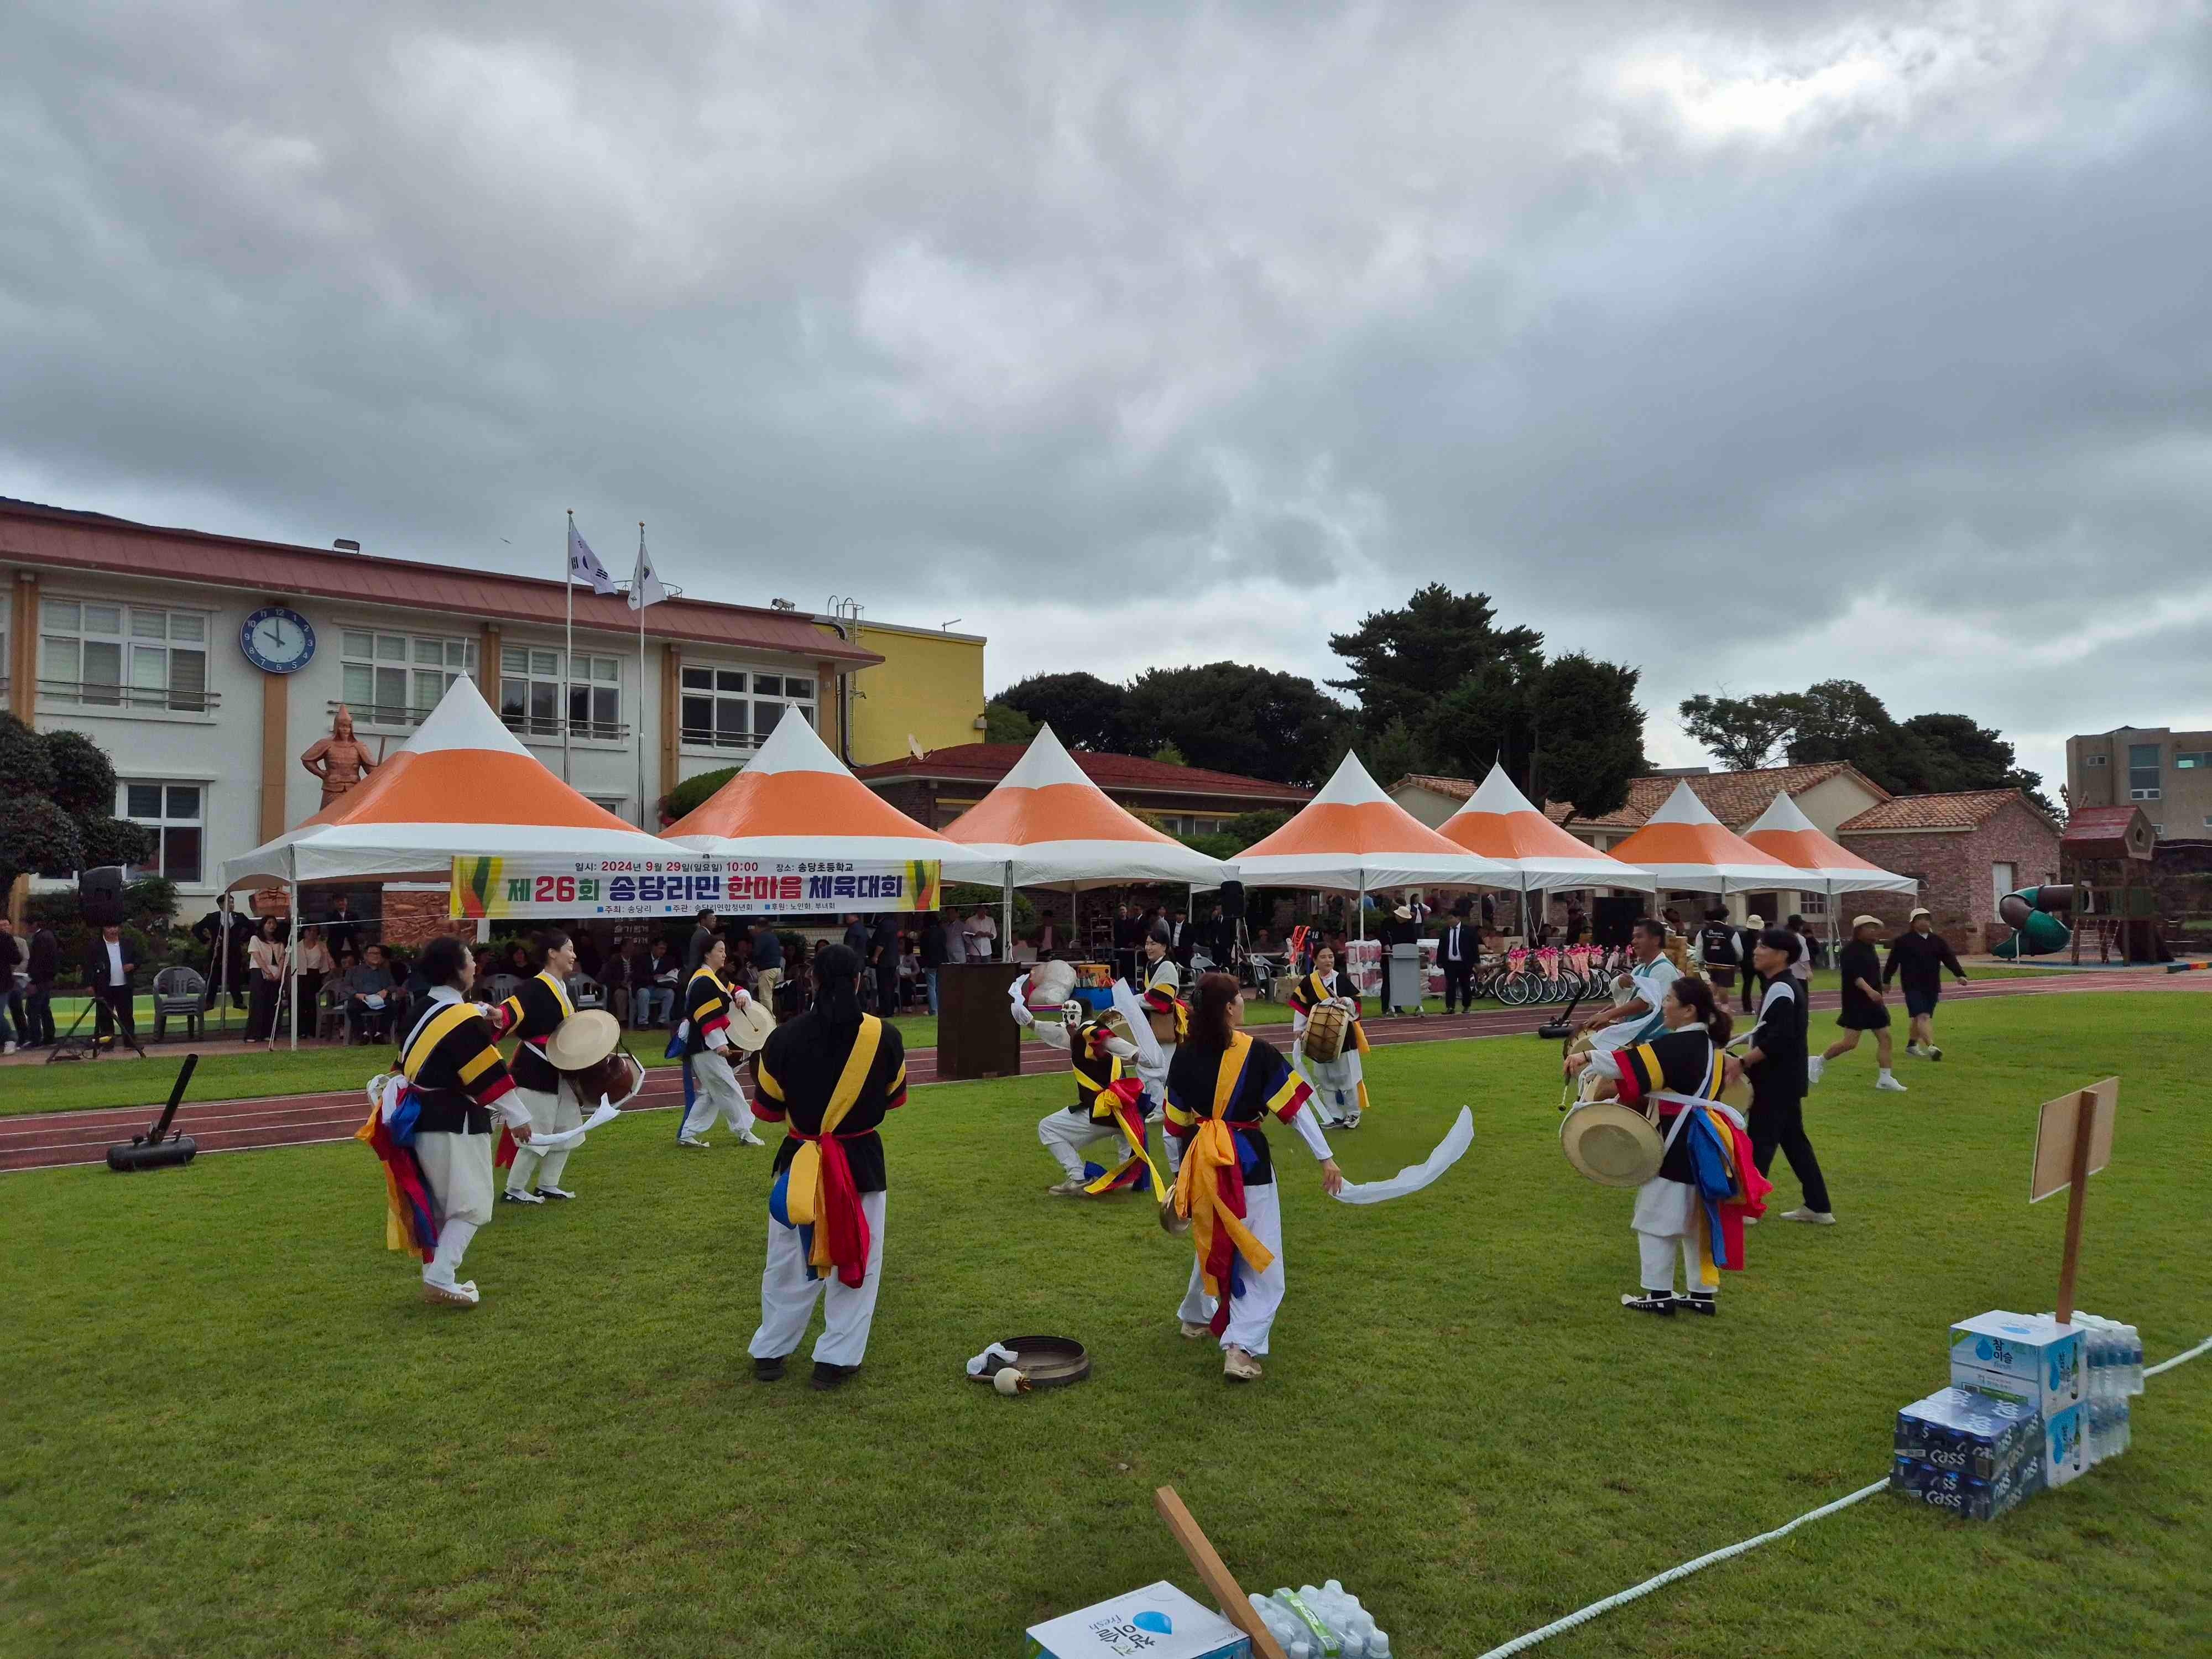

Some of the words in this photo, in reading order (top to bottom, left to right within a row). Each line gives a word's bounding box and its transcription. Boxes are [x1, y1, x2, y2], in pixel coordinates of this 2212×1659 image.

[575, 862, 597, 872] 일시:
[601, 861, 641, 872] 2024년
[645, 862, 662, 872] 9월
[666, 862, 722, 872] 29일(일요일)
[726, 862, 758, 872] 10:00
[776, 863, 795, 872] 장소:
[797, 863, 854, 872] 송당초등학교
[507, 875, 600, 902] 제26회
[609, 875, 720, 901] 송당리민
[727, 875, 802, 900] 한마음
[808, 875, 902, 899] 체육대회
[604, 905, 624, 914] 주최:
[628, 905, 651, 914] 송당리
[672, 904, 692, 913] 주관:
[1992, 1339, 2004, 1352] 참
[1994, 1351, 2013, 1364] 이슬
[1088, 1614, 1121, 1630] fresh
[1095, 1625, 1136, 1643] 이슬
[1128, 1634, 1156, 1650] 참
